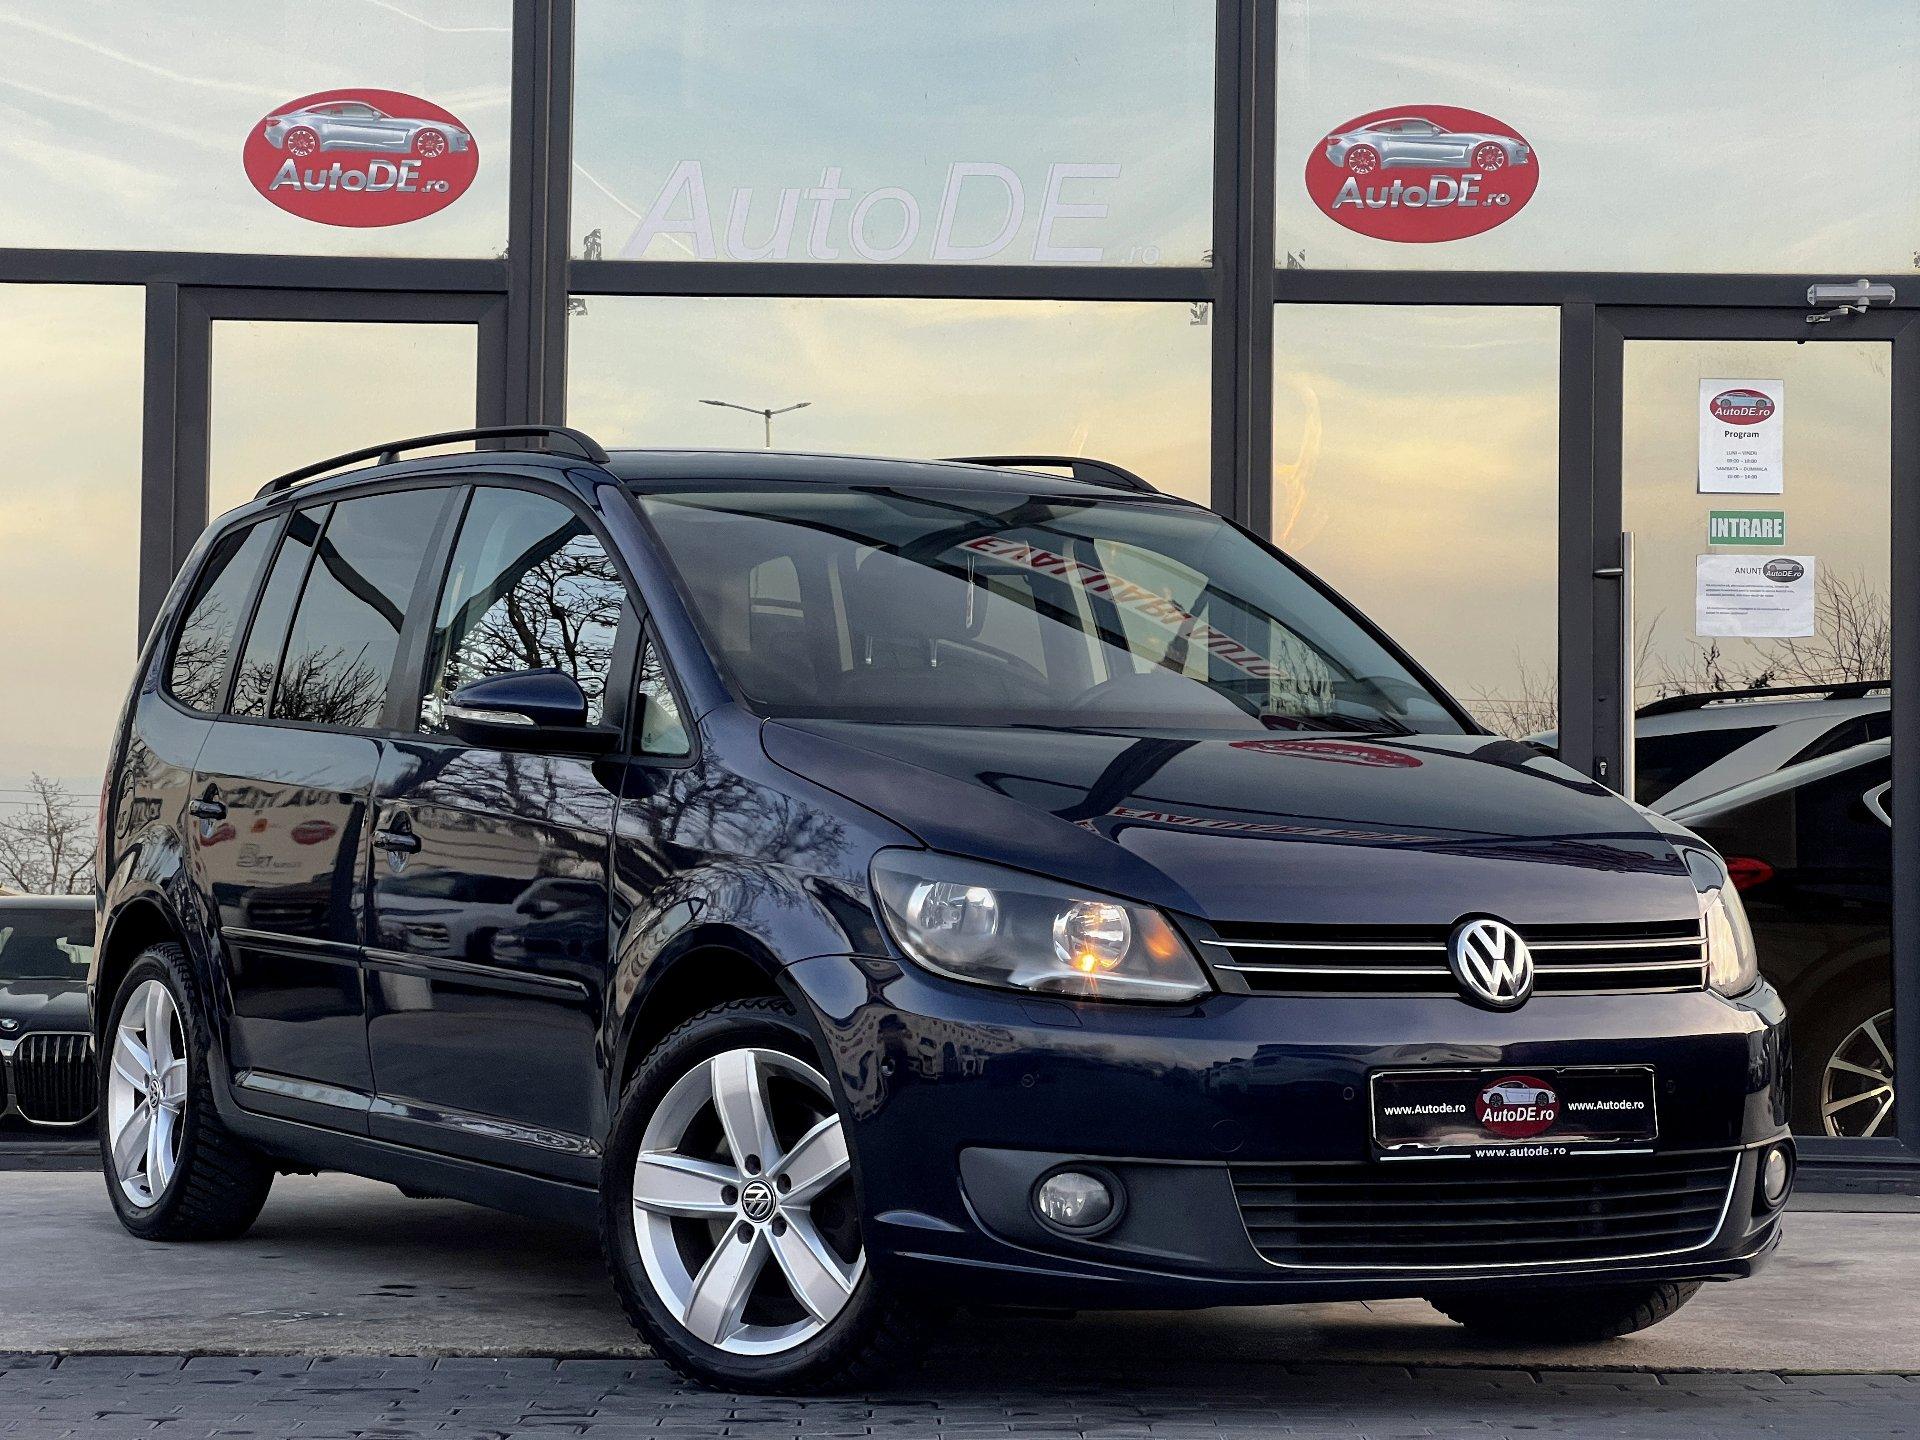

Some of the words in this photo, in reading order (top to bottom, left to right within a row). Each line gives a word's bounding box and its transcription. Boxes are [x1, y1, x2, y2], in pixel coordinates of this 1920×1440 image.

[1714, 407, 1771, 417] AutoDE.ro
[1724, 430, 1760, 440] Program
[1711, 518, 1783, 538] INTRARE
[1384, 1102, 1466, 1116] www.Autode.ro
[1567, 1099, 1645, 1111] www.Autode.ro
[1481, 1107, 1555, 1123] AutoDE.ro
[1475, 1146, 1567, 1158] www.autode.ro
